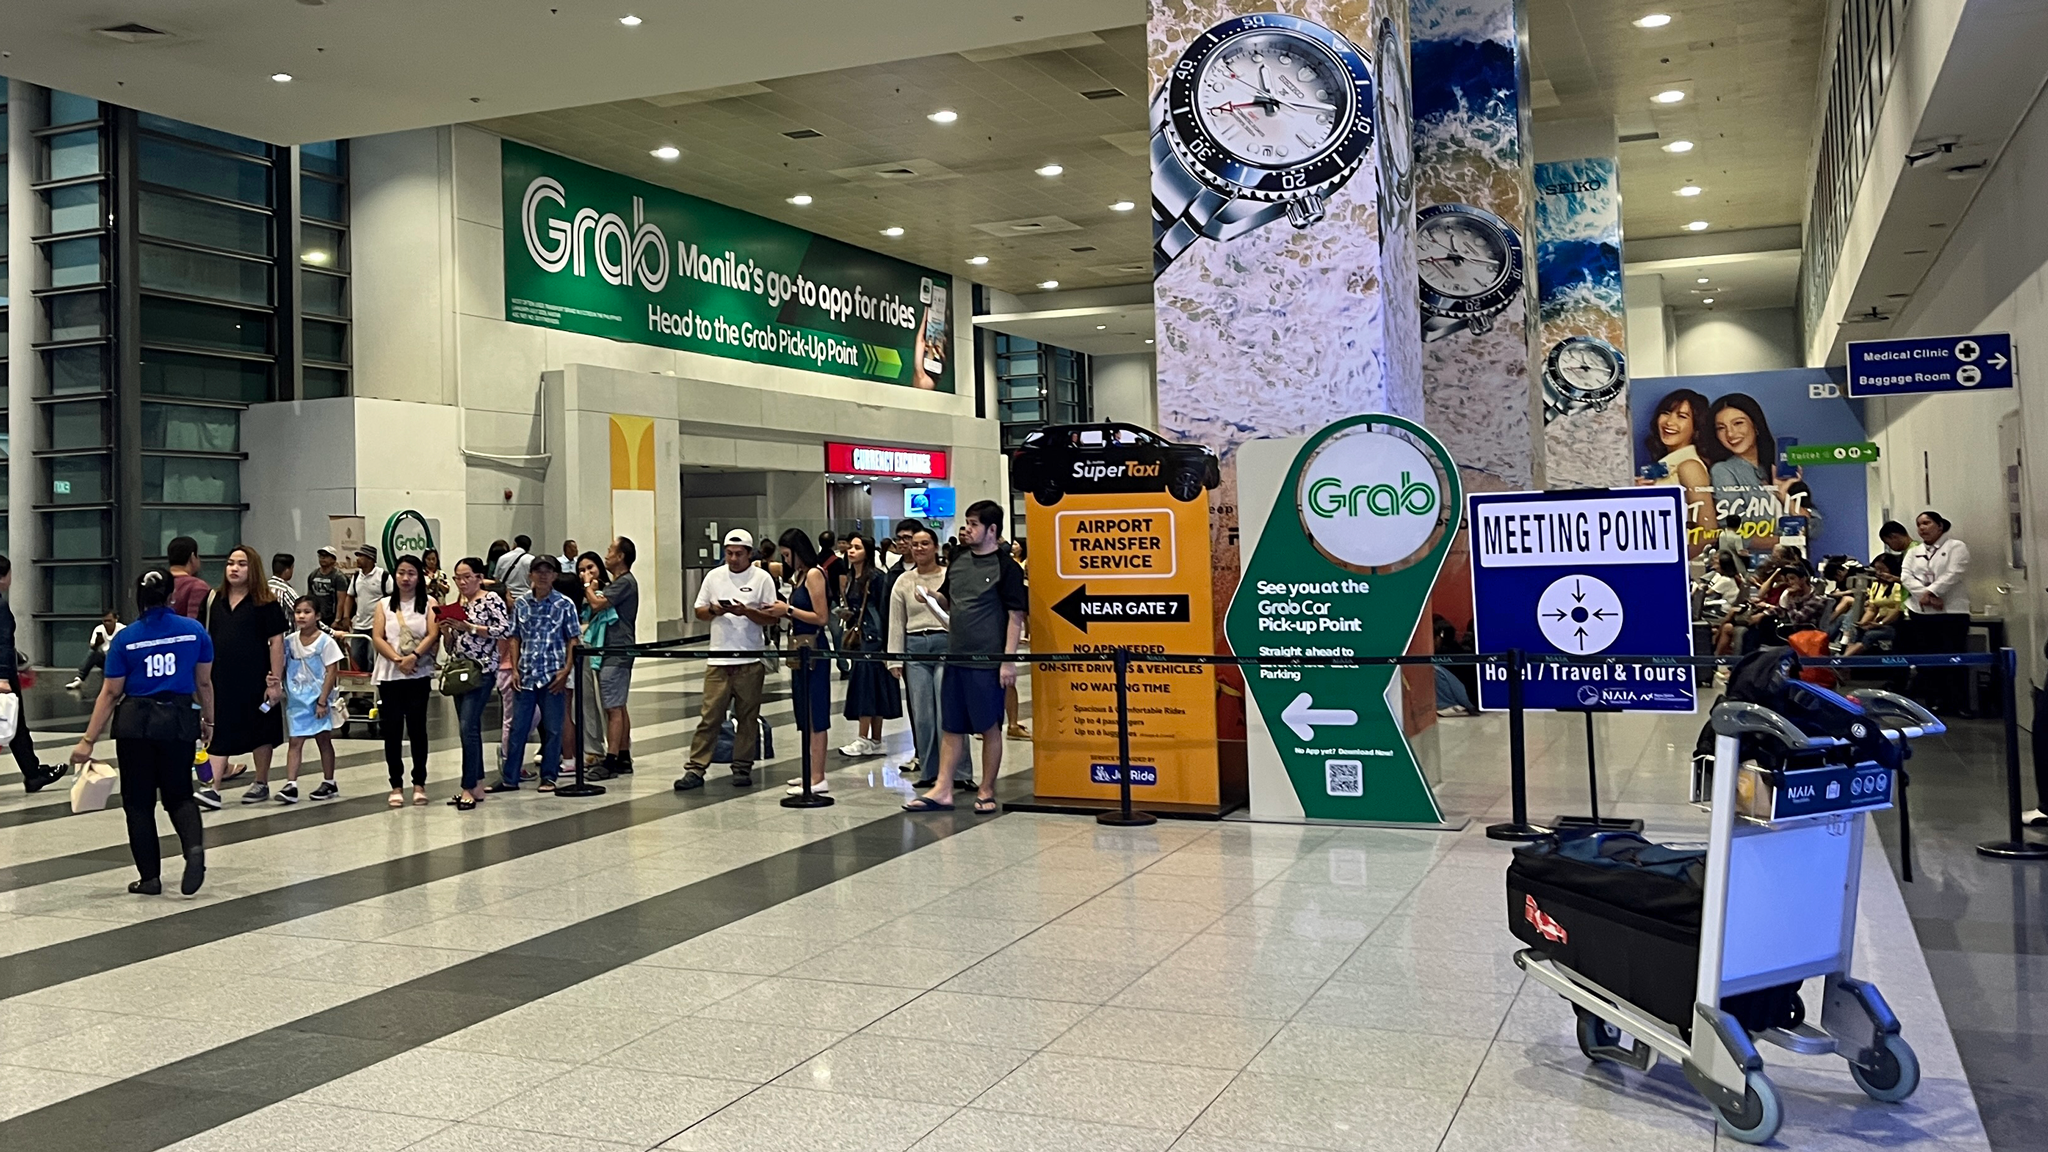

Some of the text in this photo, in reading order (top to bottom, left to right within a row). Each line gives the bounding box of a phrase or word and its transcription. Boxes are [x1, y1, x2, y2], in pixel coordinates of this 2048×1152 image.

[1241, 16, 1264, 26] 50
[1176, 59, 1192, 80] 40
[1356, 115, 1372, 135] 10
[1189, 139, 1212, 162] 30
[1282, 173, 1307, 189] 20
[1546, 180, 1601, 195] SEIKO
[521, 175, 670, 293] Grab
[678, 240, 916, 330] Manila's go-to app for rides
[648, 303, 693, 338] Head
[694, 314, 712, 340] to
[714, 315, 740, 346] the
[741, 322, 777, 352] Grab
[779, 328, 826, 366] Pick-Up
[828, 338, 858, 366] Point
[1864, 348, 1949, 362] Medical Clinic
[1859, 372, 1951, 386] Baggage Room
[1808, 383, 1840, 399] BD
[1308, 471, 1436, 518] Grab
[1209, 506, 1234, 517] eep
[1716, 494, 1782, 520] SCAN
[1076, 518, 1153, 534] AIRPORT
[1484, 510, 1672, 555] MEETING POINT
[395, 532, 426, 551] Grab
[1070, 536, 1161, 552] TRANSFER
[1079, 554, 1152, 570] SERVICE
[1257, 579, 1370, 598] See you at the
[1080, 602, 1178, 615] NEAR GATE 7
[1258, 599, 1332, 615] Grab Car
[1258, 617, 1362, 634] Pick-up Point
[1073, 644, 1091, 654] NO
[1258, 646, 1355, 658] Straight ahead to
[144, 653, 176, 678] 198
[1039, 662, 1204, 674] ON-SITE DRIVS & VEHICLES
[1486, 663, 1532, 681] Hol
[1550, 663, 1608, 680] Travel
[1614, 664, 1627, 681] &
[1632, 664, 1687, 682] Tours
[1260, 668, 1301, 682] Parking
[1070, 682, 1171, 692] NO WAITNG TIME
[1074, 705, 1107, 713] Spacious
[1116, 706, 1162, 715] Cmfortable
[1074, 717, 1085, 726] Up
[1102, 718, 1144, 728] passgers
[1074, 728, 1086, 737] Up
[1103, 728, 1138, 738] lugges
[1112, 770, 1155, 782] JRide
